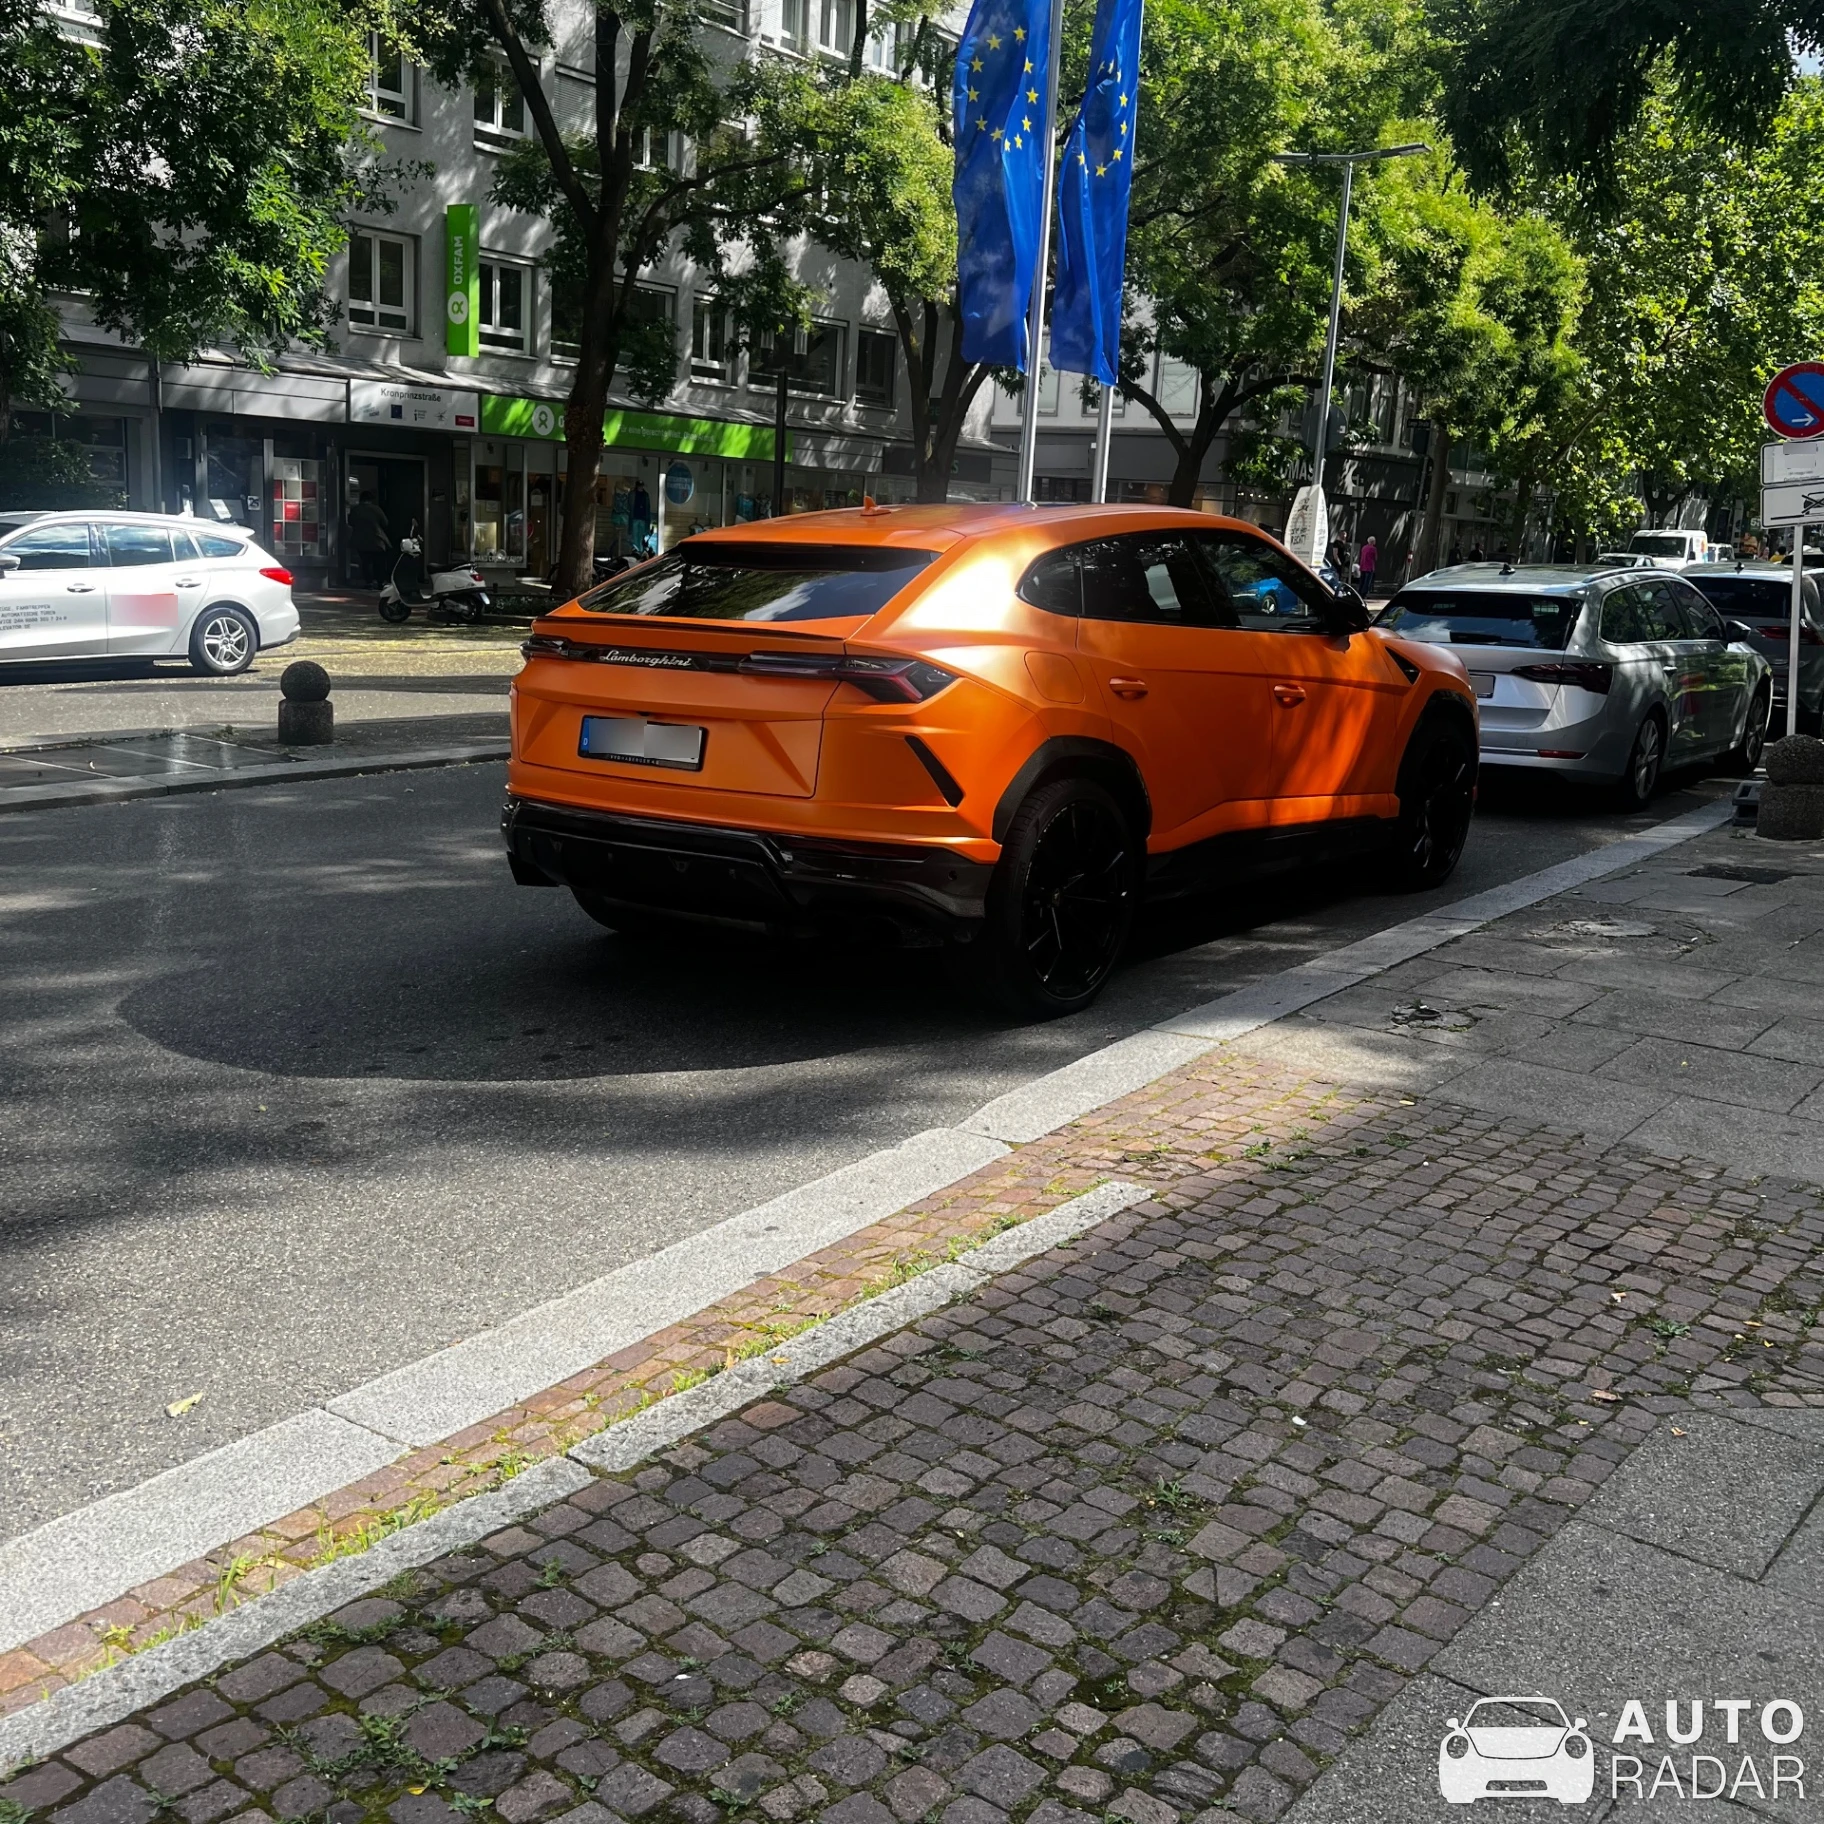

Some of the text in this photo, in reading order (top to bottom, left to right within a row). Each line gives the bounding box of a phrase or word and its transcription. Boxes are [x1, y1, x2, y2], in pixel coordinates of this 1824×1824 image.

[454, 235, 464, 285] OXFAM
[381, 388, 441, 403] Kronprinzstraße
[600, 649, 692, 666] Lamborghini
[583, 738, 589, 746] D
